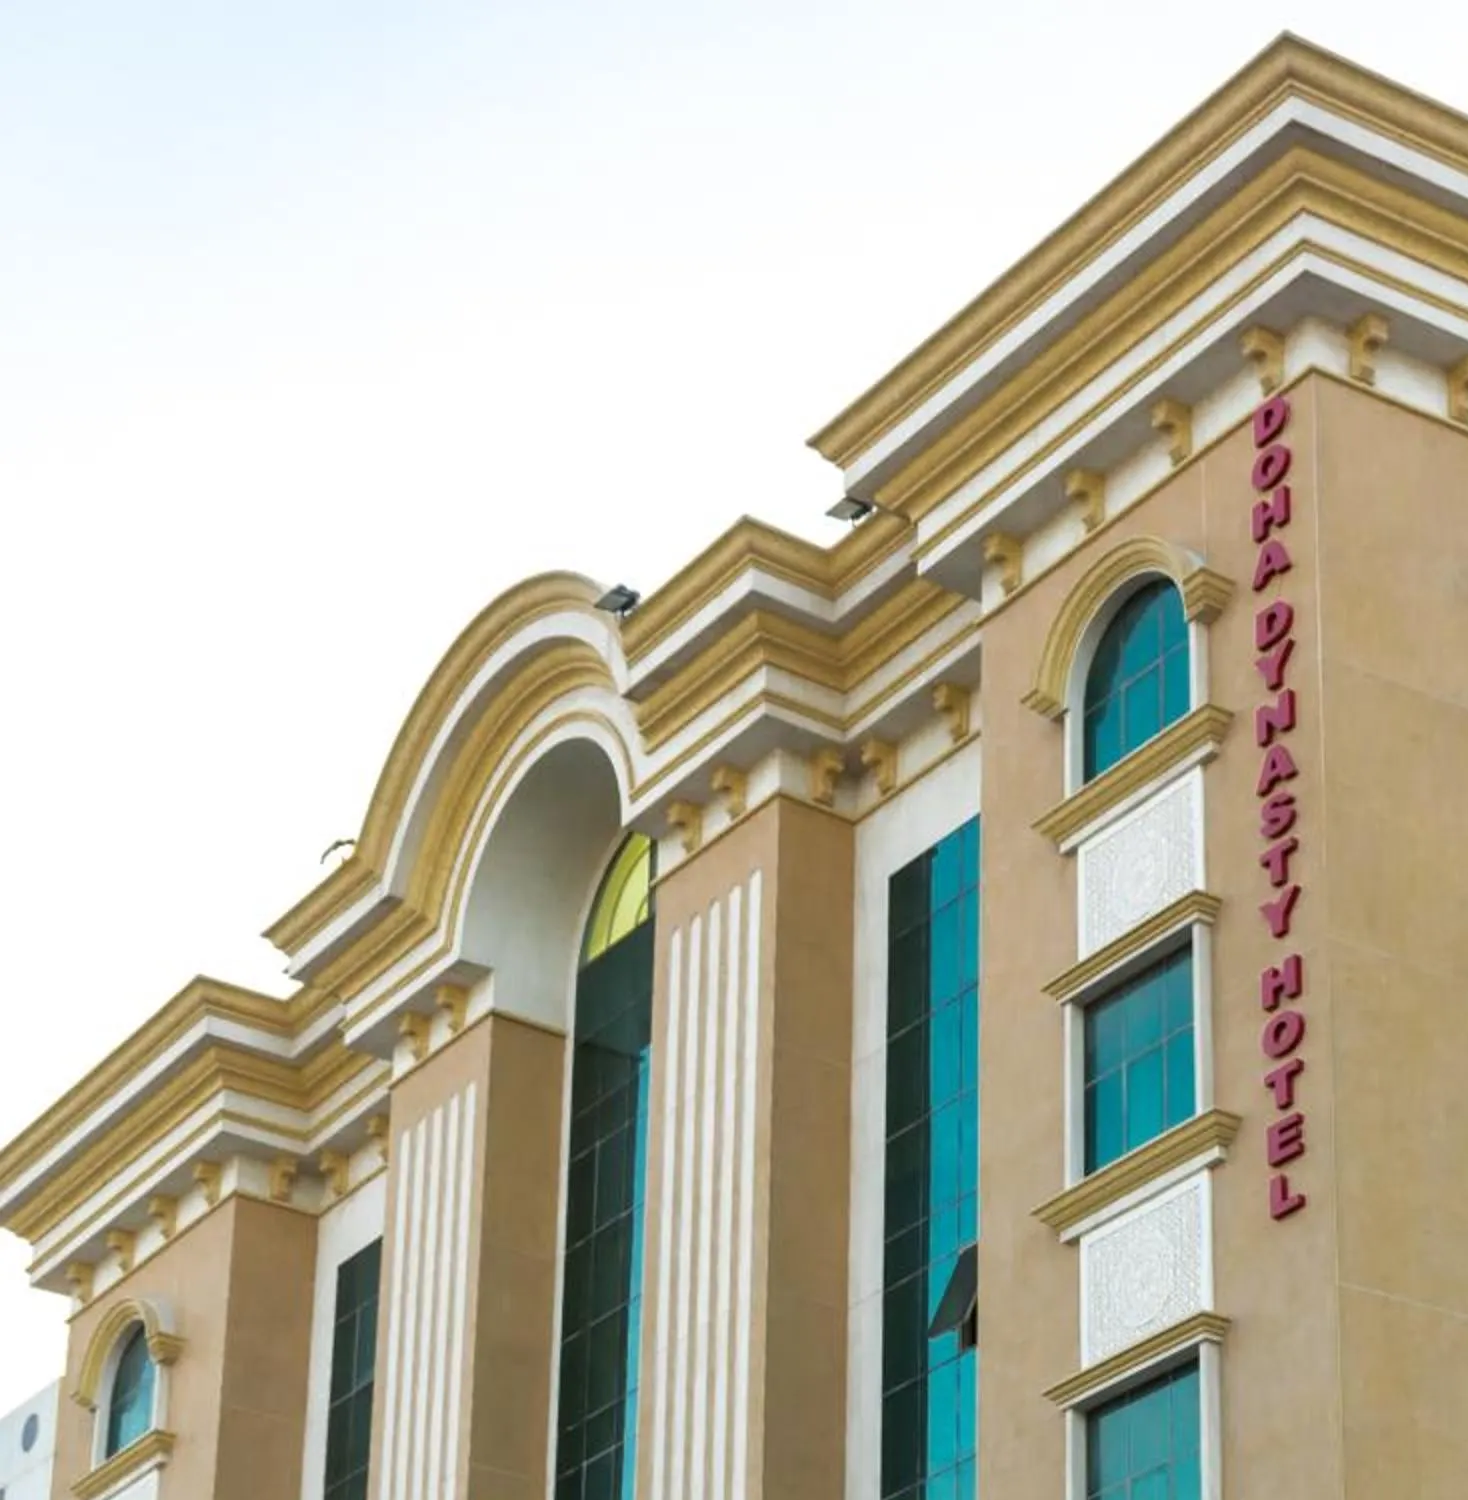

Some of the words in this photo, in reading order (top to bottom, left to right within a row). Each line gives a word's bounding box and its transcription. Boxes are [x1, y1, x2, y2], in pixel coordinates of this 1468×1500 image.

[1251, 394, 1293, 592] DOHA
[1254, 599, 1302, 939] DYNASTY
[1260, 953, 1306, 1221] HOTEL
